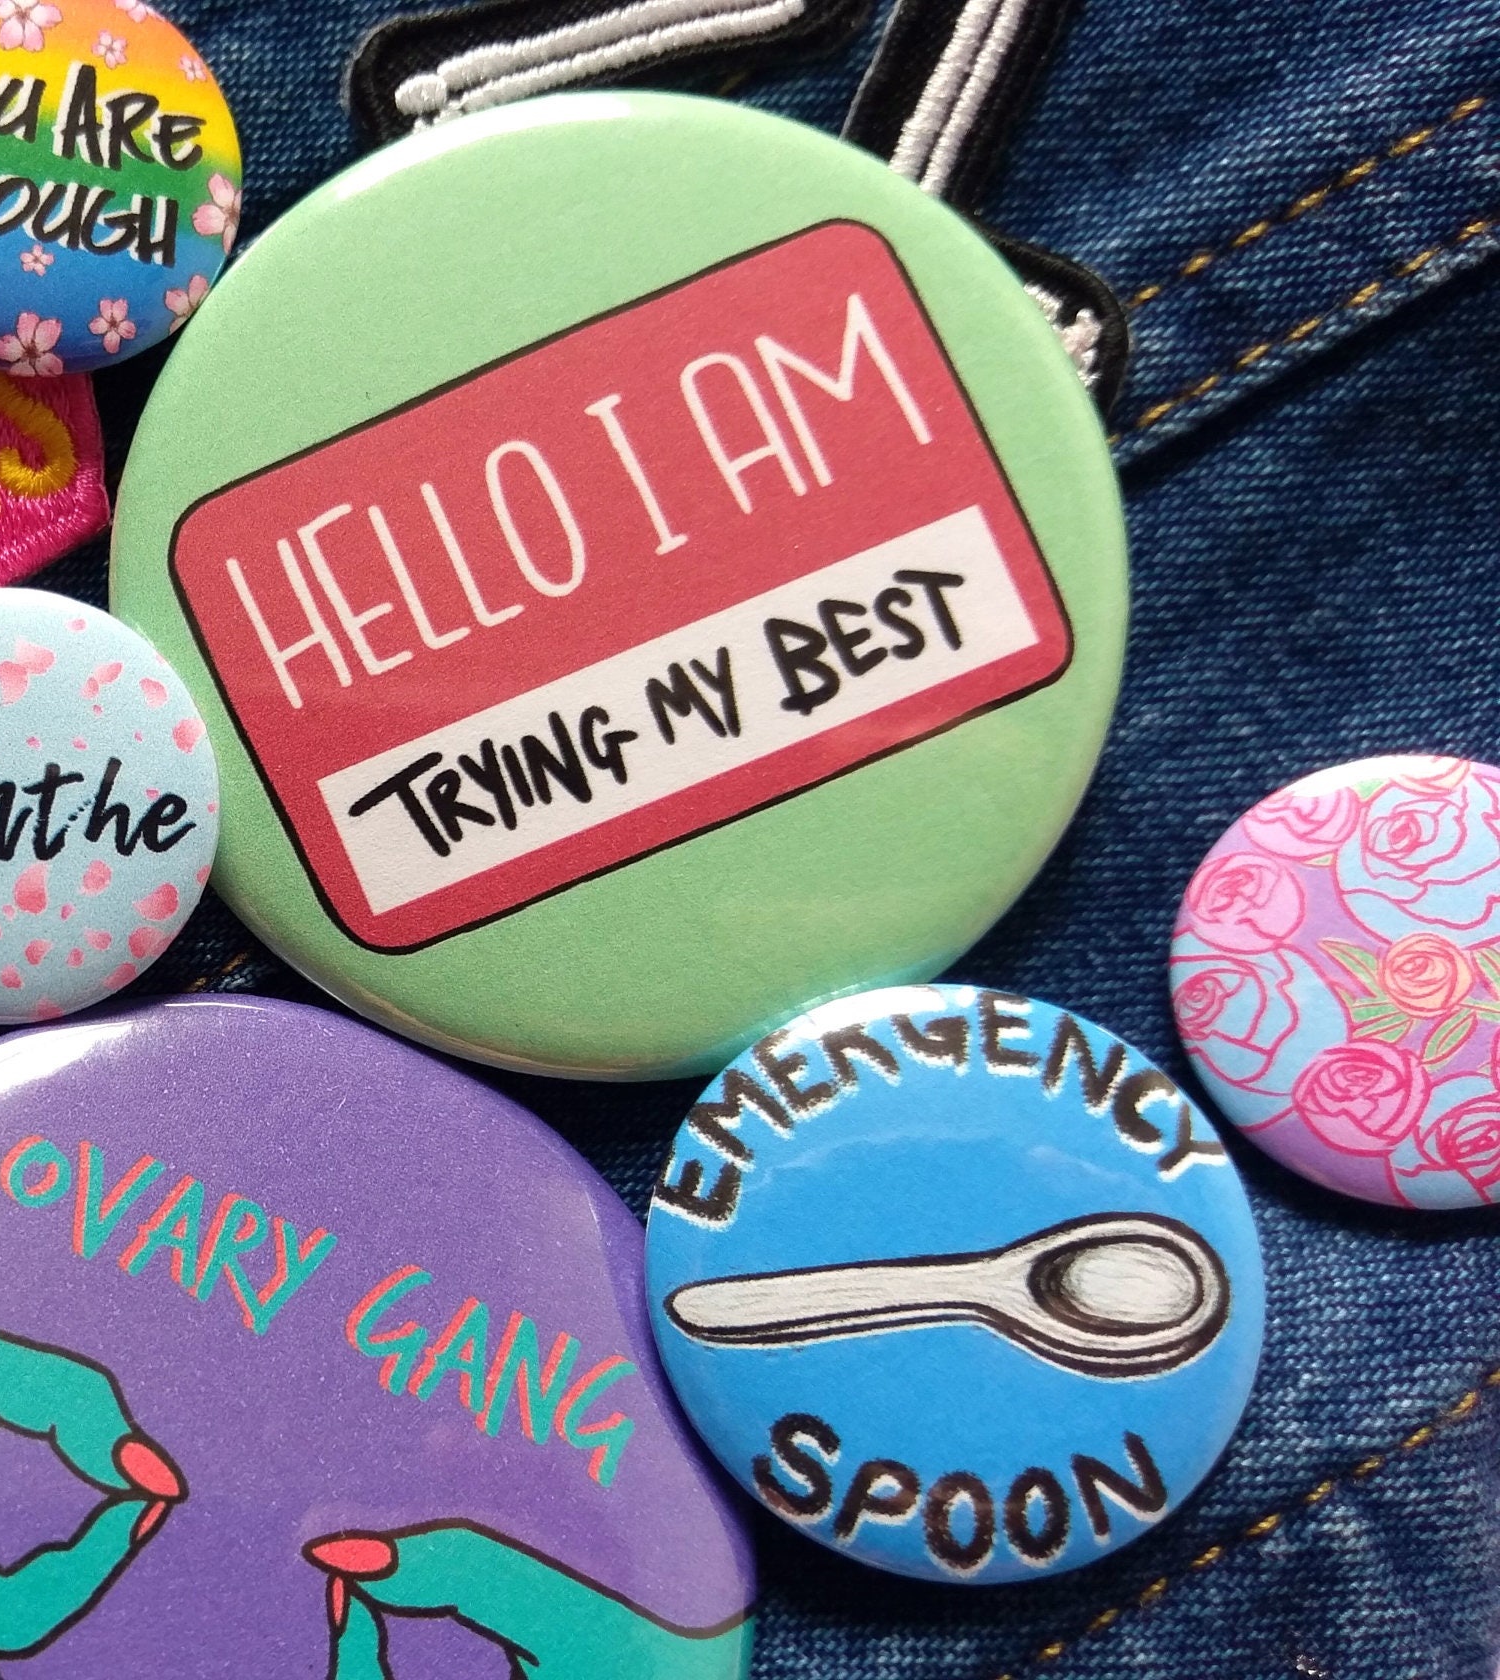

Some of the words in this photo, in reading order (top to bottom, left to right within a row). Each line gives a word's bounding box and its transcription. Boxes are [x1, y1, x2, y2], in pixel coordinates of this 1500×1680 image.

[52, 61, 208, 171] ARE
[225, 438, 587, 710] HELLO
[585, 394, 687, 556] I
[679, 293, 934, 517] AM
[349, 707, 638, 858] TRYING
[646, 645, 742, 745] MY
[764, 569, 966, 715] BEST
[0, 1135, 339, 1336] OVARY
[346, 1264, 638, 1487] GANG
[751, 1411, 1169, 1579] SPOON
